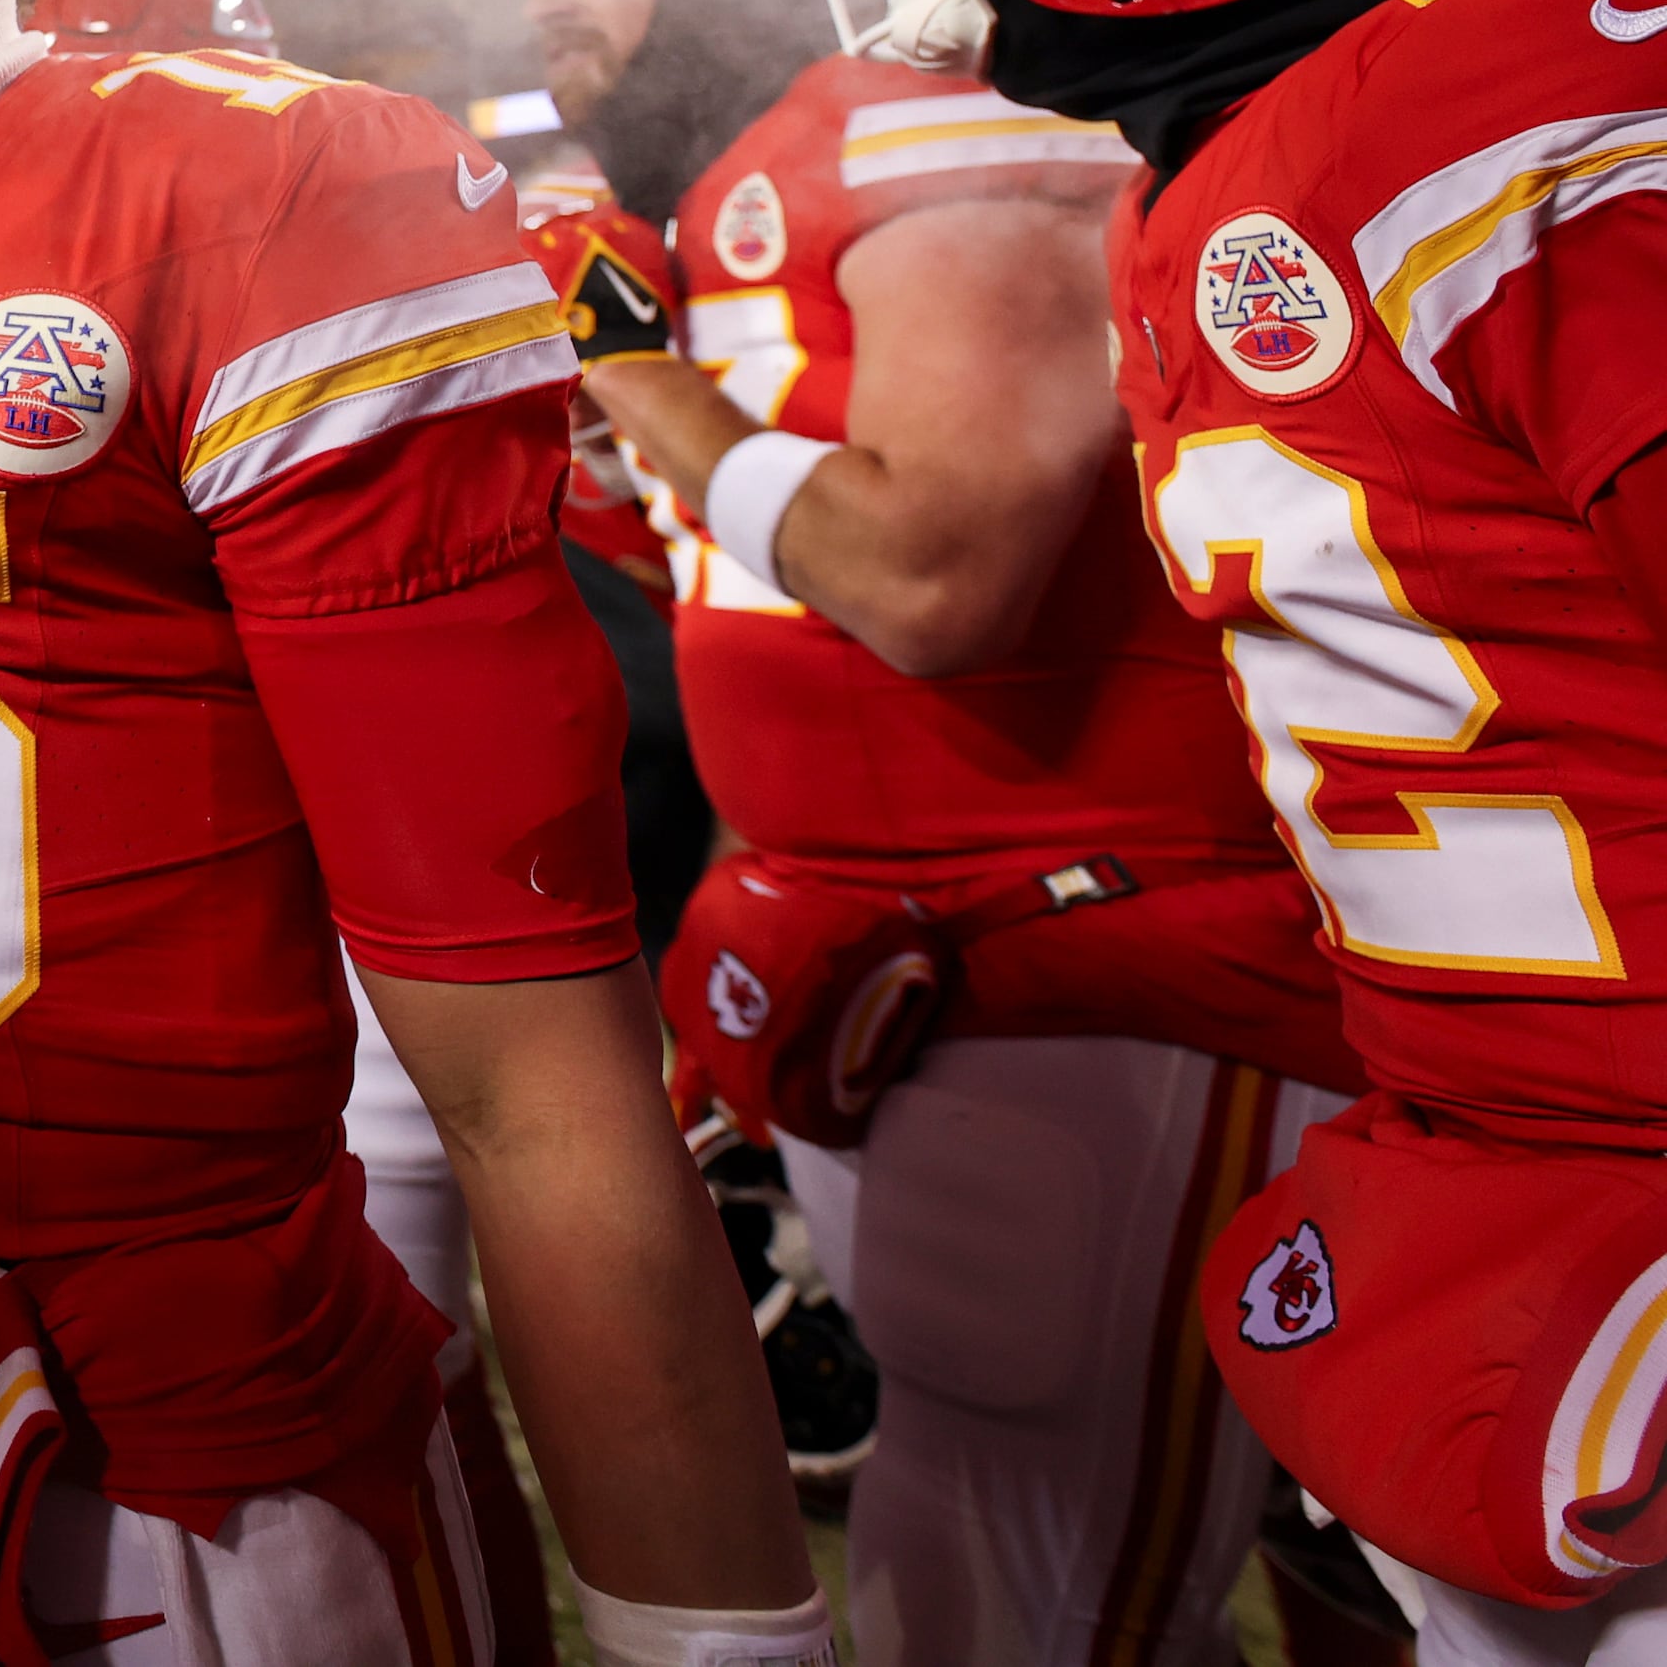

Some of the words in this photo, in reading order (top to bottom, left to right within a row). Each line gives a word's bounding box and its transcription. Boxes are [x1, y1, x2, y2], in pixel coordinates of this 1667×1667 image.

[1253, 333, 1292, 356] LH
[5, 407, 52, 436] LH
[1268, 1250, 1323, 1333] KC
